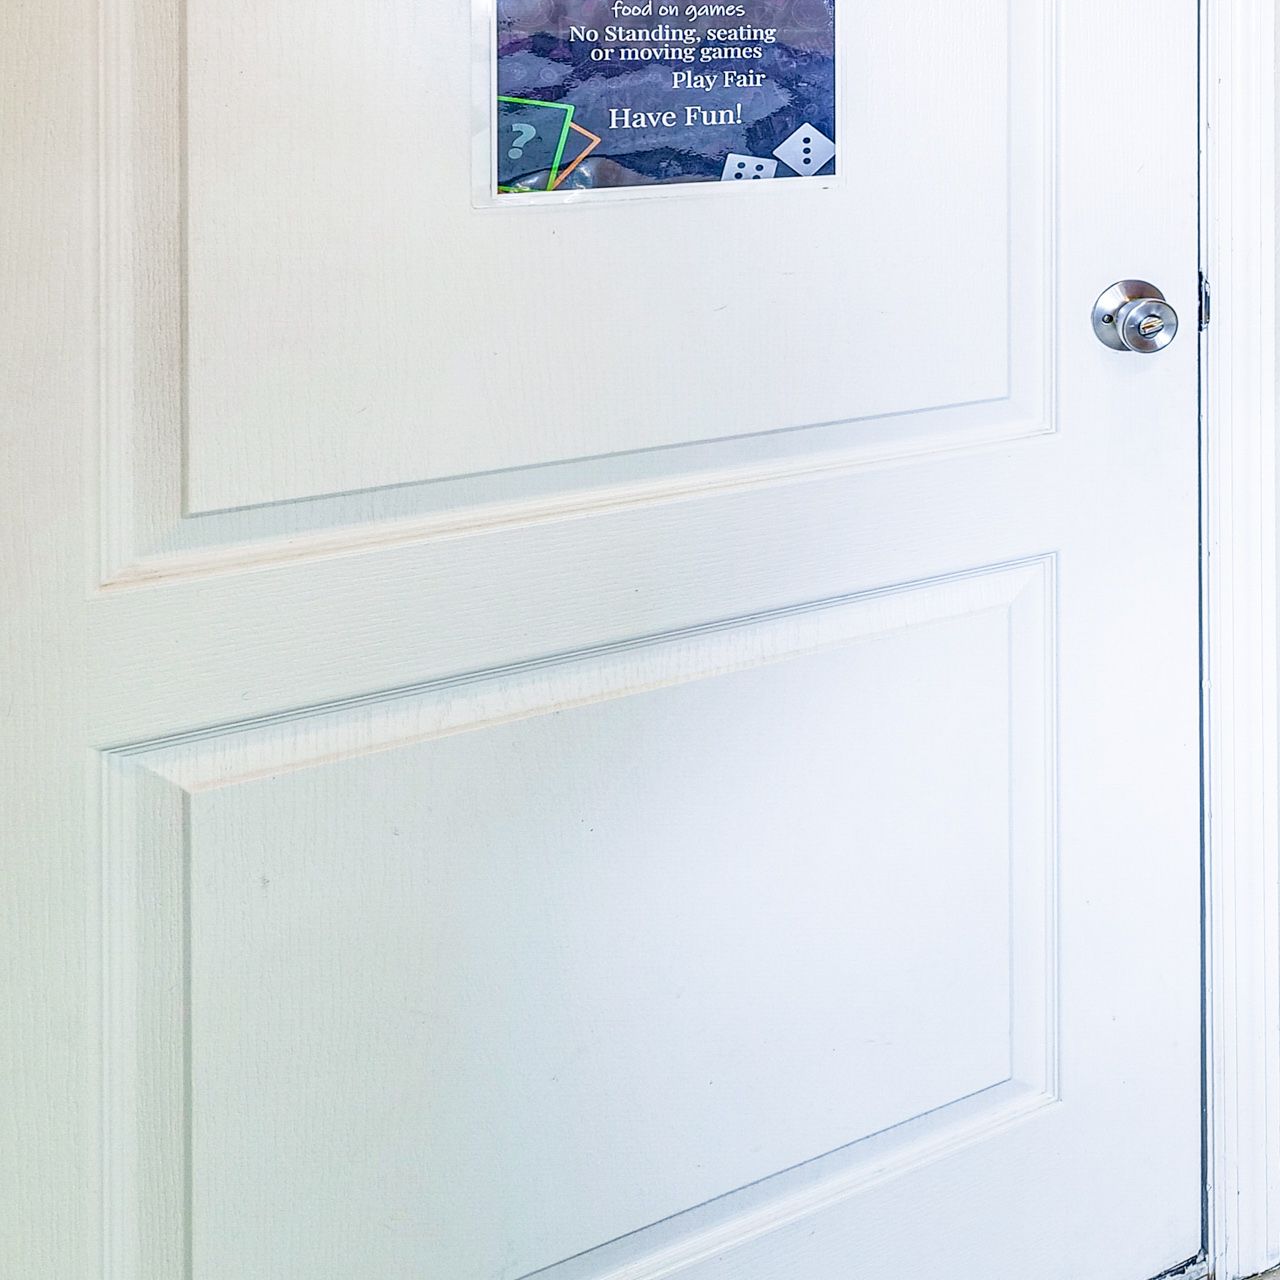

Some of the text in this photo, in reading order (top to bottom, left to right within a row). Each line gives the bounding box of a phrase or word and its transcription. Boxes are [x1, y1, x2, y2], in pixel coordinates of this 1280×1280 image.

[611, 0, 746, 22] food on games
[569, 25, 777, 44] No Standing, seating
[590, 44, 762, 63] or moving games
[672, 70, 766, 92] Play Fair
[608, 103, 742, 129] Have Fun!
